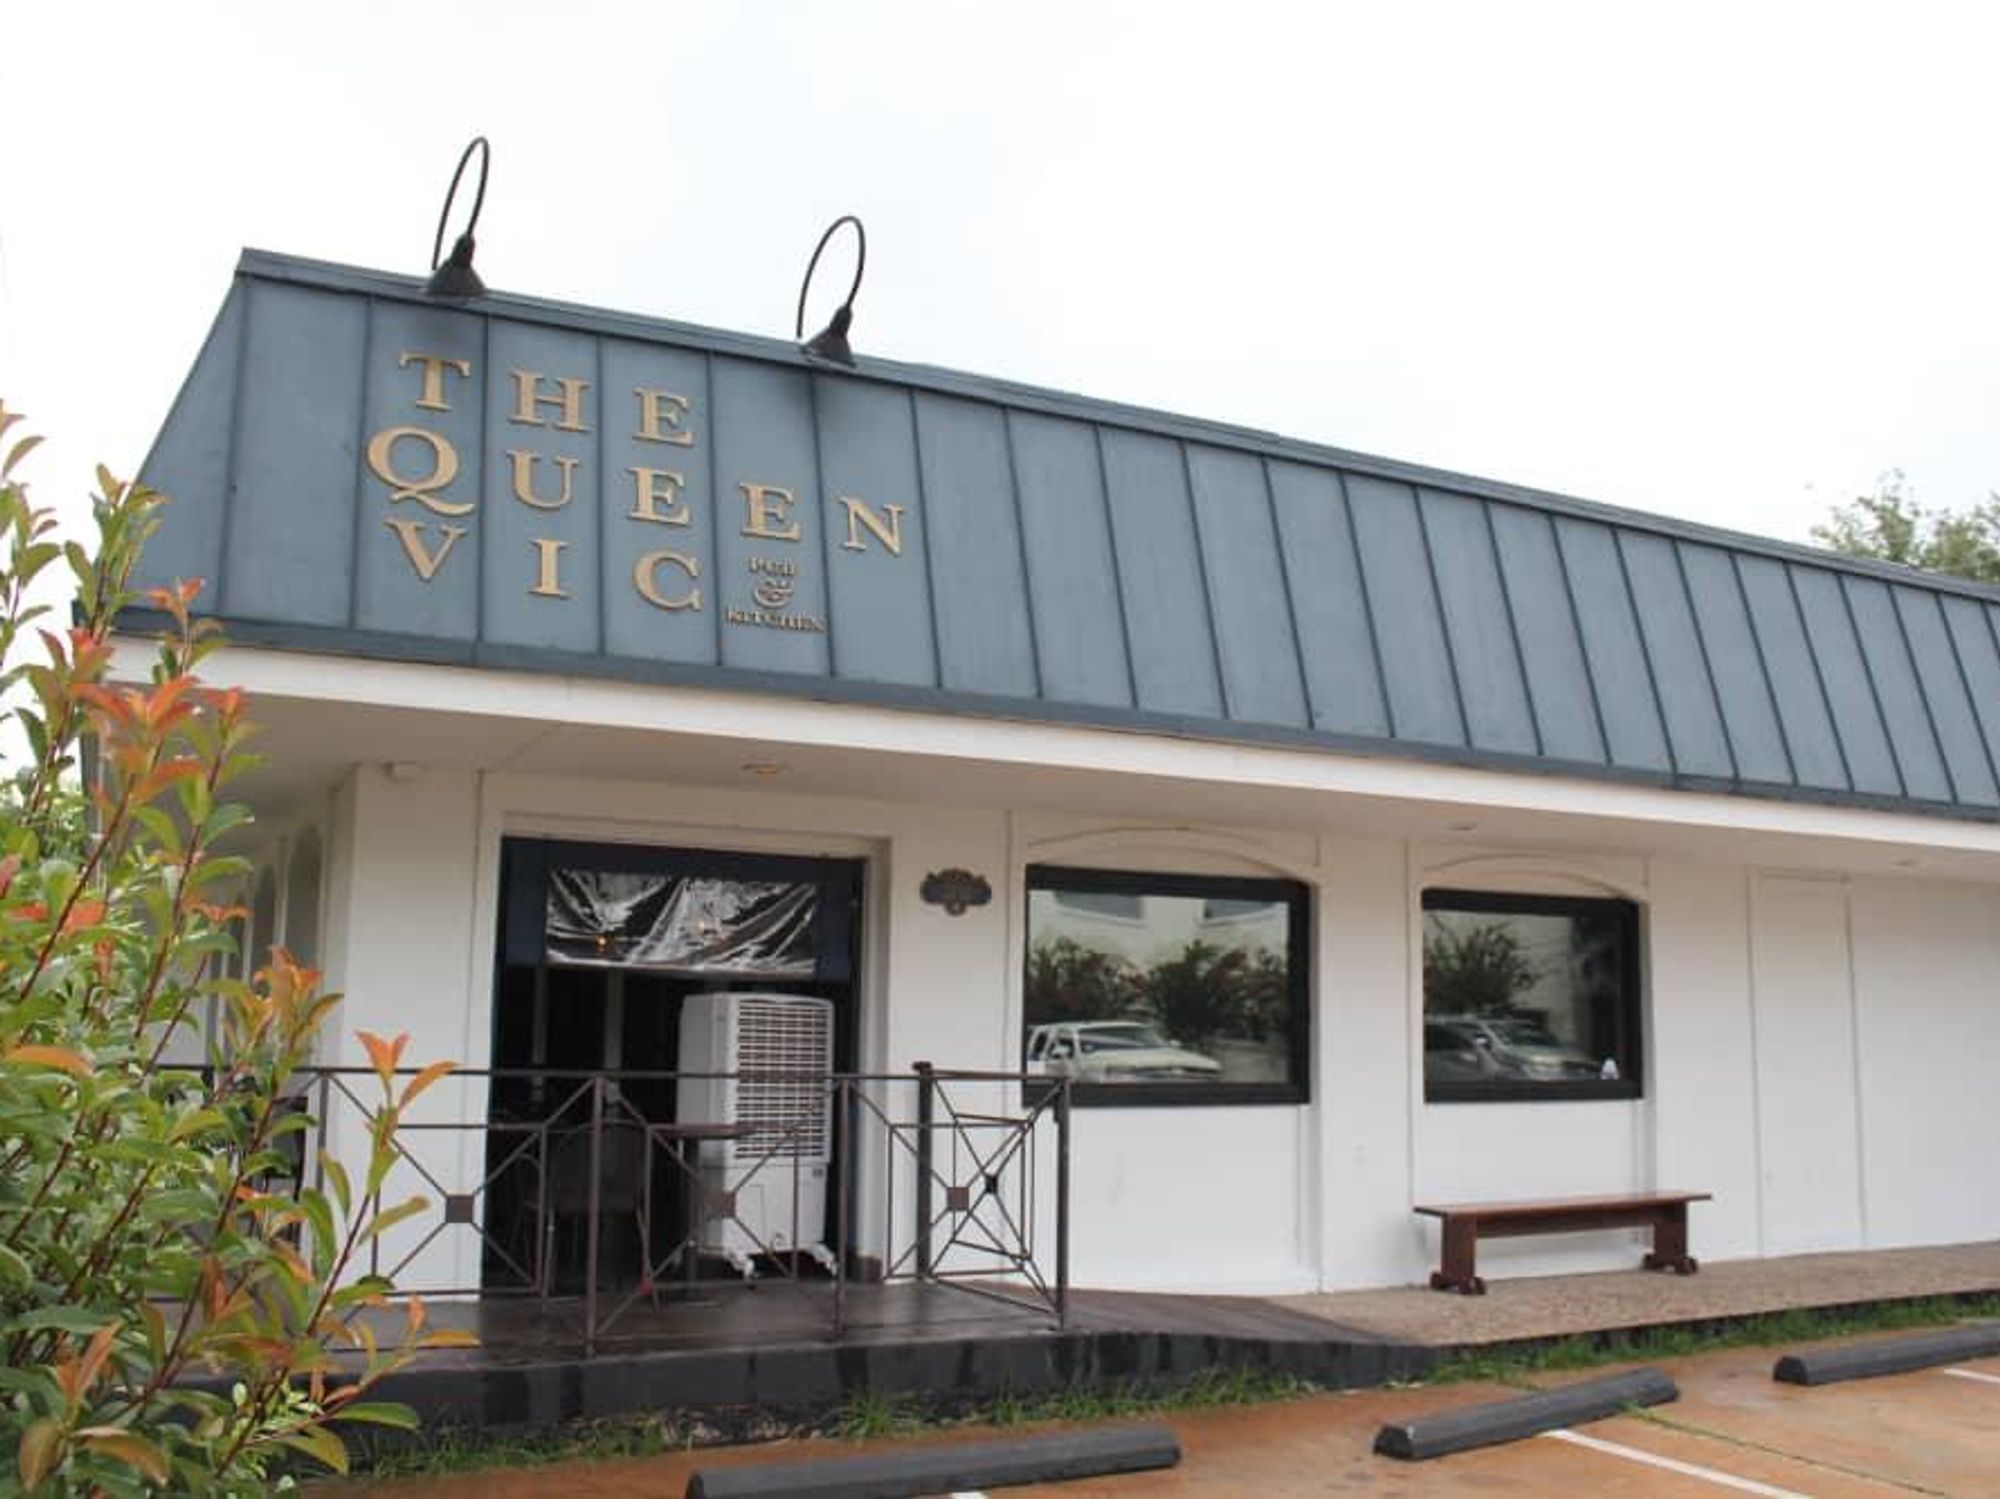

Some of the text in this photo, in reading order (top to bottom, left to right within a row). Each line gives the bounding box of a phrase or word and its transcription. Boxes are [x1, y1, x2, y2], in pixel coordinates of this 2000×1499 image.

[401, 353, 693, 446] THE
[367, 425, 905, 556] QUEEN
[384, 519, 702, 611] VIC
